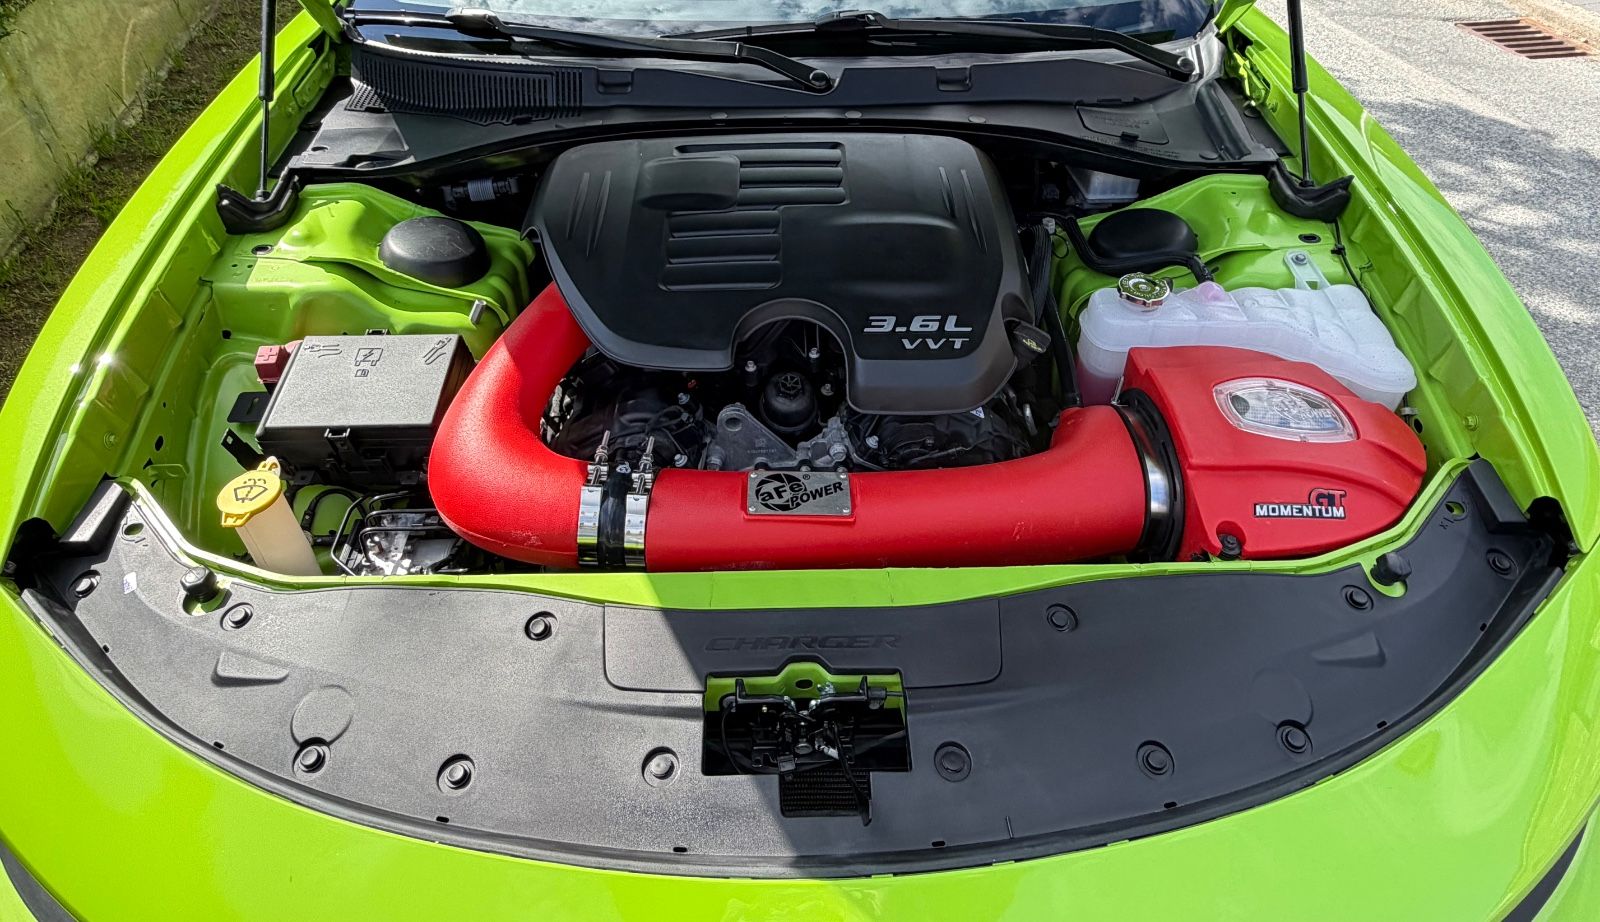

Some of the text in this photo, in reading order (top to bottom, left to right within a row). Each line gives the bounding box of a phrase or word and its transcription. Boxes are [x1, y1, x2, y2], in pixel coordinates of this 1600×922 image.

[863, 315, 973, 332] 3.6L
[901, 338, 970, 350] VVT
[760, 482, 804, 502] aFe
[790, 481, 844, 507] POWER
[1310, 488, 1346, 508] GT
[1255, 504, 1345, 518] MOMENTUM
[704, 634, 900, 652] CHARGER
